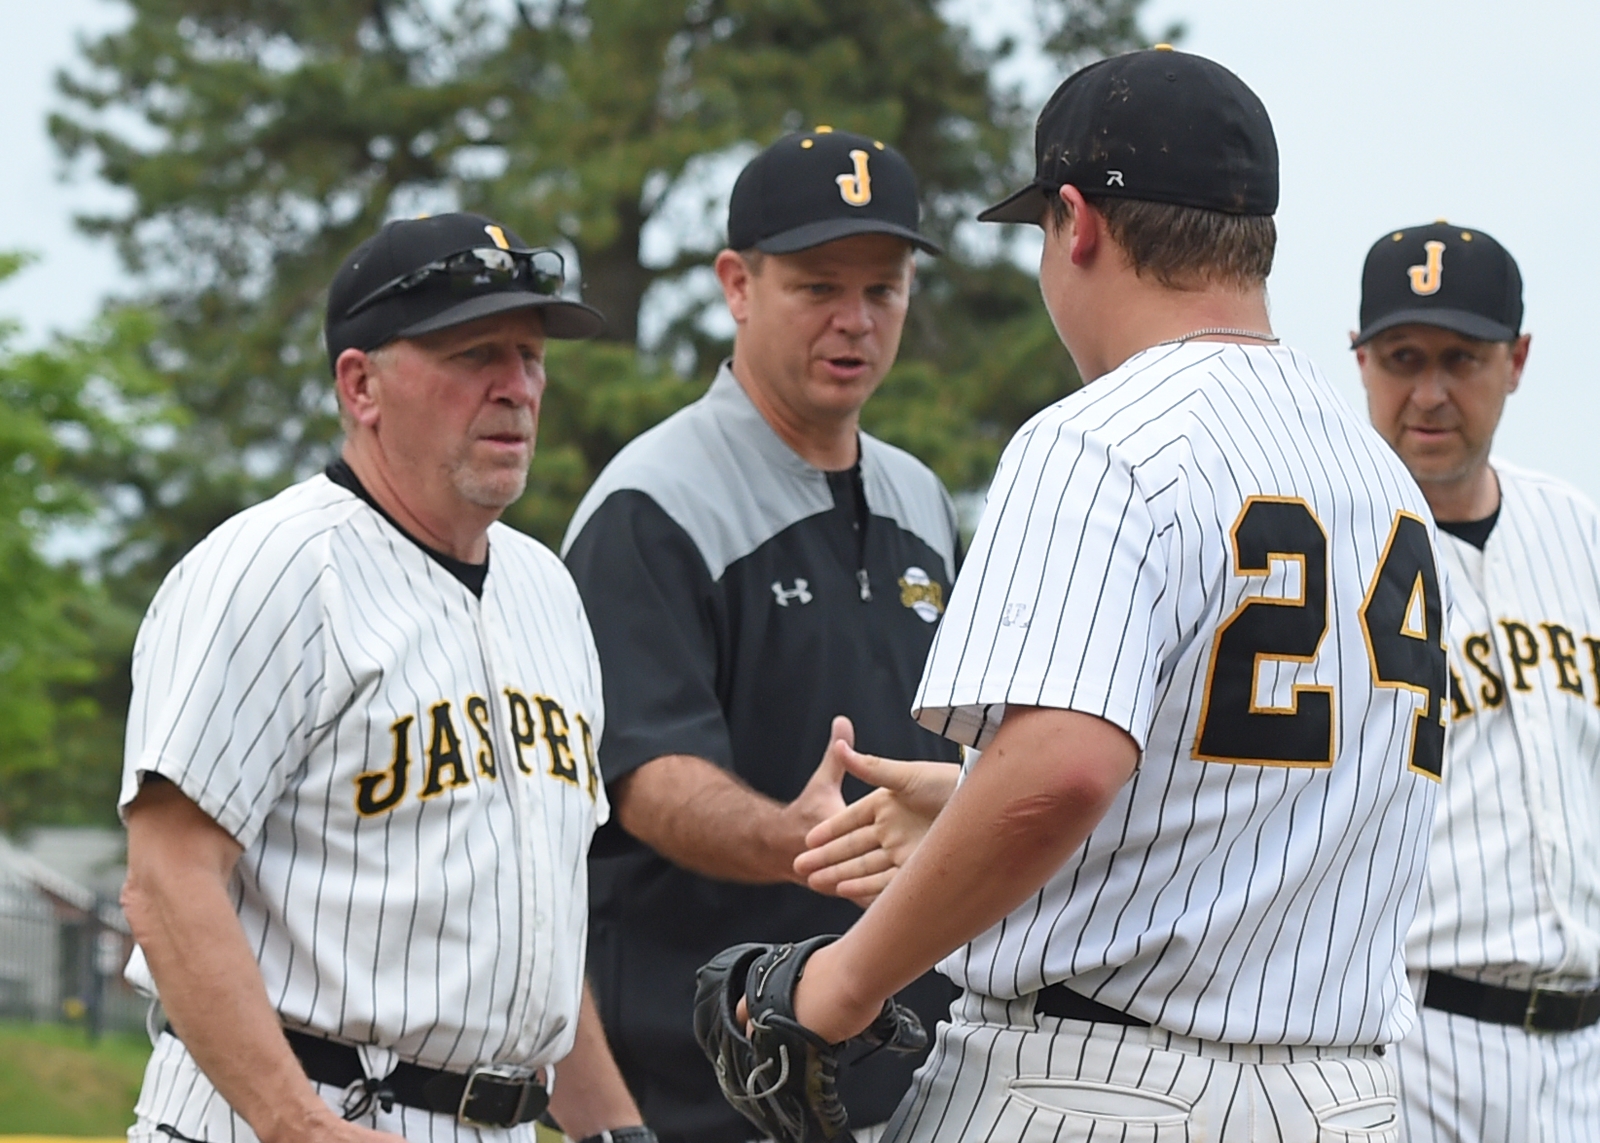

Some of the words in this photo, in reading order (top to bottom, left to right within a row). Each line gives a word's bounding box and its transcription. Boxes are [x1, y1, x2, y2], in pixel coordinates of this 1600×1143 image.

[835, 149, 872, 207] J
[1407, 240, 1446, 296] J
[1190, 495, 1448, 784] 24
[1448, 617, 1600, 724] SPE
